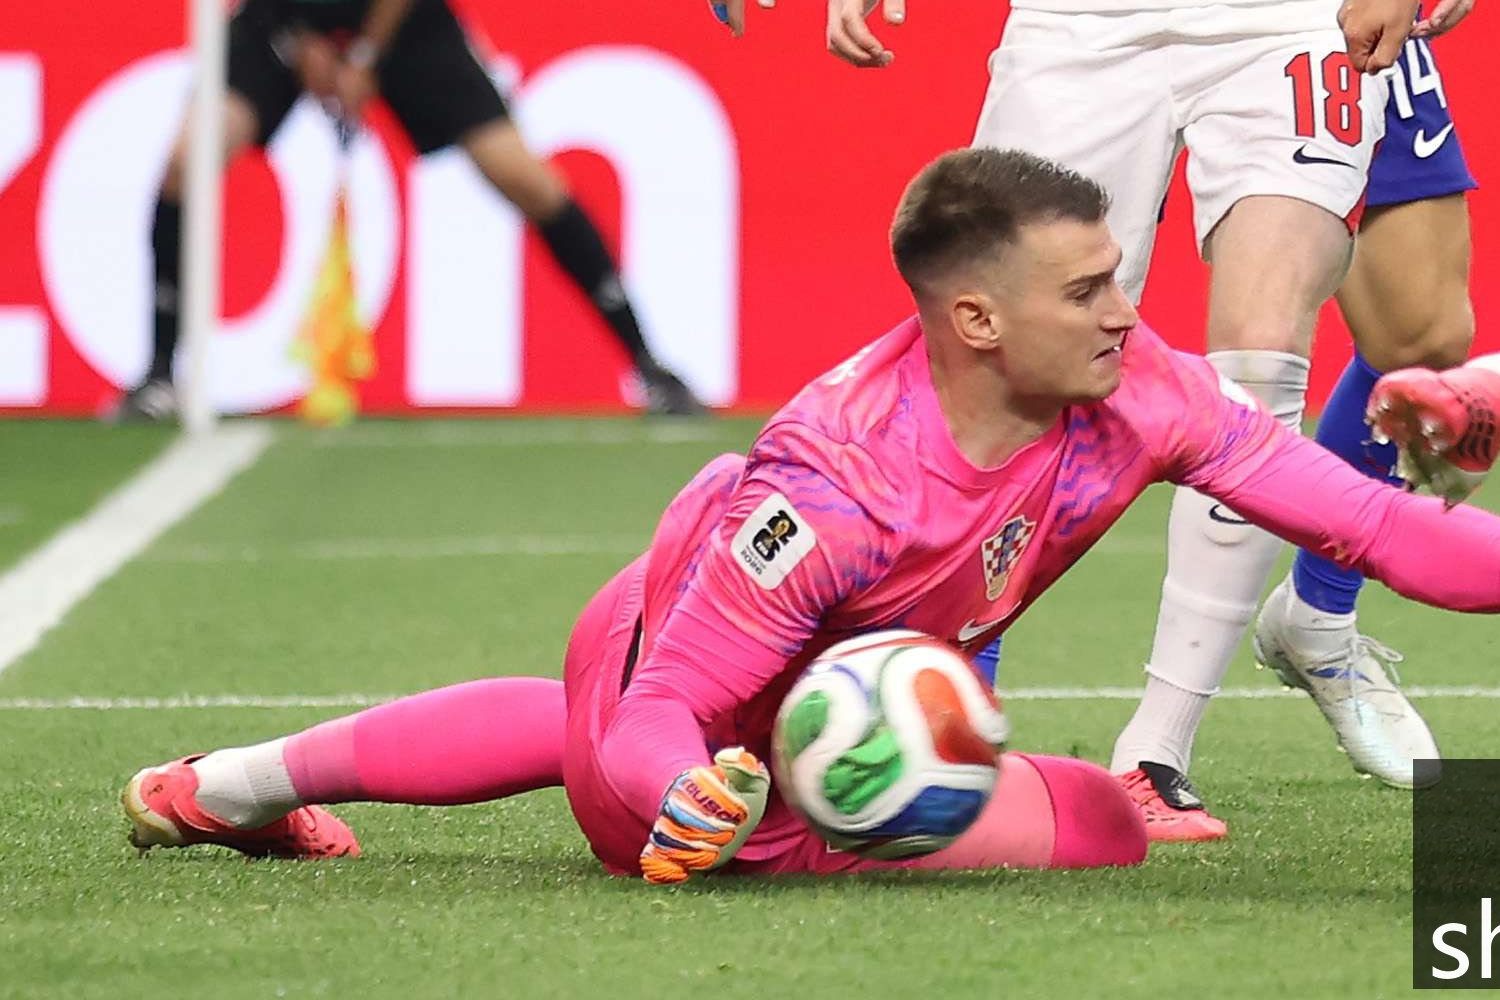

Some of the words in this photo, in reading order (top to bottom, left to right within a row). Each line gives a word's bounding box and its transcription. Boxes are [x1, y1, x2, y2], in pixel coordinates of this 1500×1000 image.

[1284, 50, 1363, 147] 18
[1386, 34, 1448, 119] 14
[0, 47, 736, 411] on
